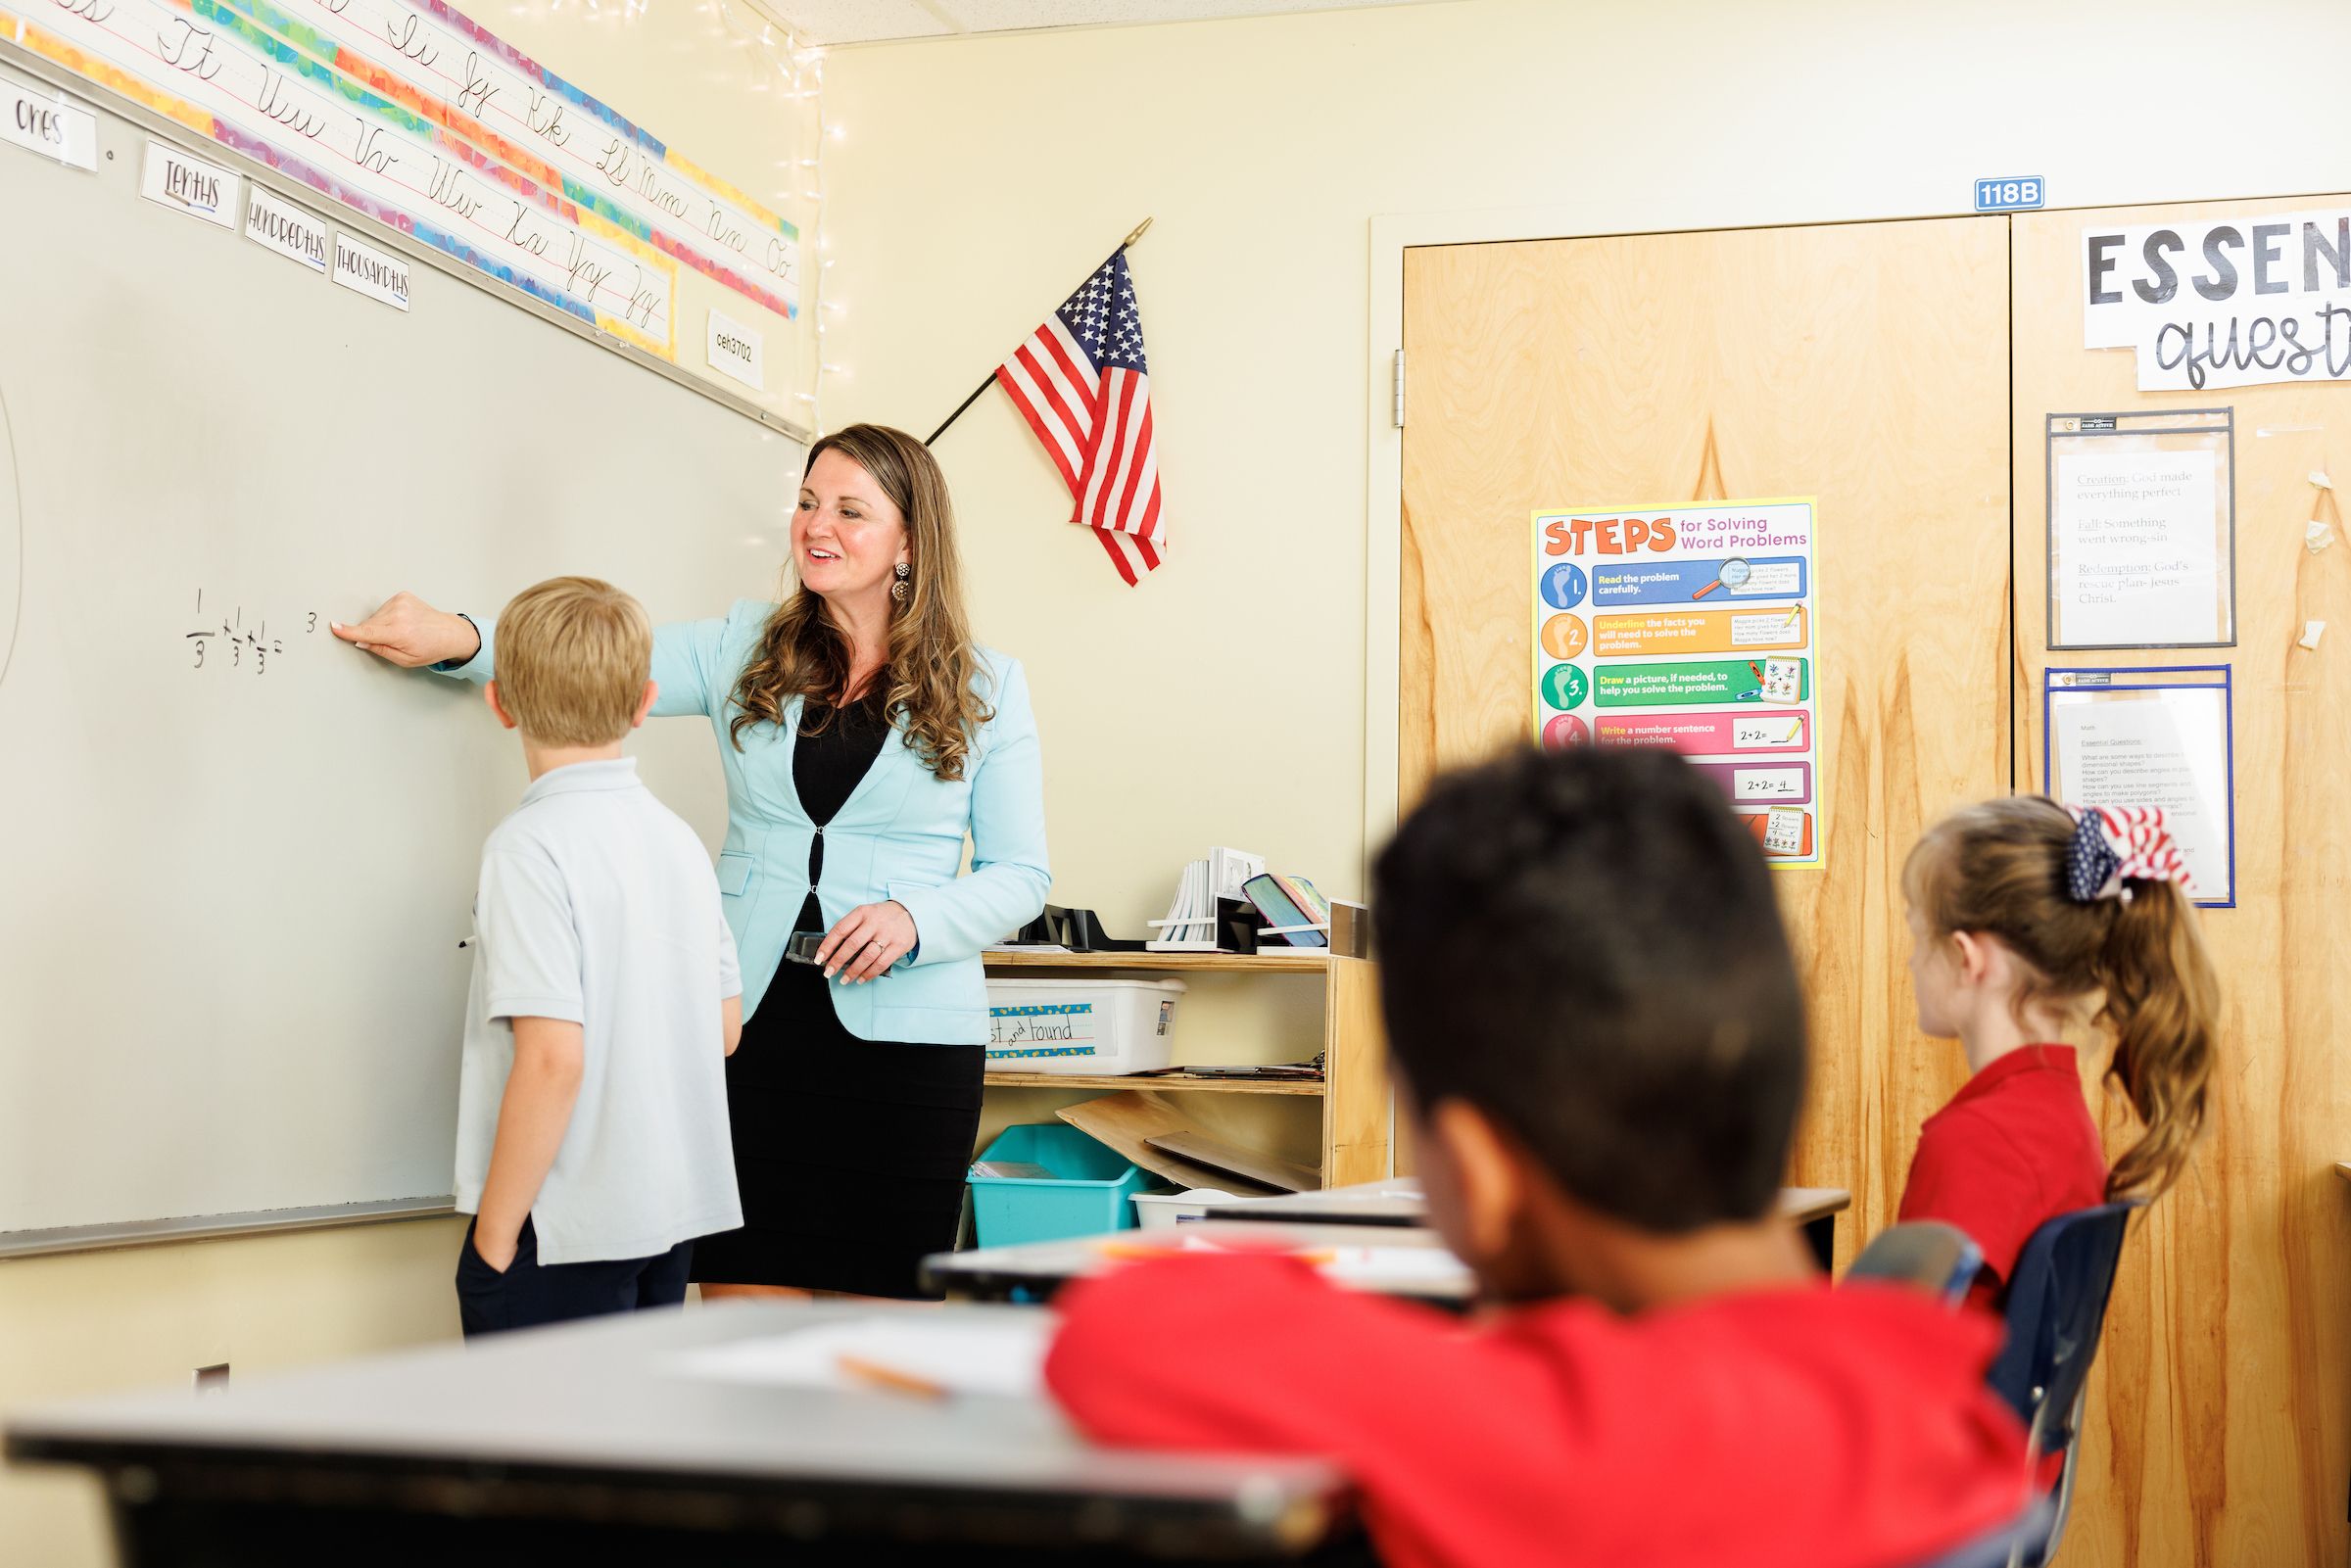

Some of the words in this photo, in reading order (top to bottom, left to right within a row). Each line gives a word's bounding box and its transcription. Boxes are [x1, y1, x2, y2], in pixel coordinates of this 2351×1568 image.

[456, 51, 500, 119] Jj
[526, 85, 571, 147] Kk
[596, 138, 633, 186] Ll
[638, 155, 689, 218] Mm
[705, 199, 748, 253] Nn
[766, 238, 792, 278] Oo
[157, 16, 222, 80] Tt
[259, 63, 326, 138] Uu
[356, 117, 400, 174] Vv
[427, 155, 483, 219] Ww
[504, 201, 551, 256] Xx
[567, 230, 612, 303] Yy
[624, 264, 661, 328] Zz
[1980, 180, 2039, 206] 118B
[2087, 215, 2350, 306] ESSEN
[716, 331, 752, 363] ceh3702
[2131, 472, 2155, 484] God
[2159, 470, 2193, 483] made
[2077, 489, 2139, 502] everything
[2141, 487, 2182, 500] perfect
[1680, 520, 1702, 533] for
[1707, 517, 1768, 534] Solving
[2103, 517, 2167, 531] Something
[1545, 517, 1676, 555] STEPS
[1681, 535, 1724, 549] Word
[1730, 532, 1807, 548] Problems
[2078, 534, 2106, 545] went
[2154, 560, 2189, 572] God's
[1599, 575, 1622, 584] Read
[1640, 573, 1680, 585] problem
[2078, 580, 2114, 589] rescue
[2149, 576, 2180, 590] Jesus
[1599, 585, 1642, 595] carefully.
[2078, 594, 2117, 605] Christ.
[1599, 619, 1645, 630] Underline
[1663, 618, 1686, 627] facts
[1688, 618, 1705, 629] you
[1568, 629, 1582, 646] 2.
[1599, 630, 1616, 640] will
[1617, 629, 1642, 639] need
[1655, 628, 1679, 638] solve
[1680, 628, 1697, 637] the
[1599, 640, 1642, 651] problem.
[1600, 676, 1624, 685] Draw
[1633, 675, 1669, 686] picture,
[1669, 674, 1678, 683] if
[1679, 673, 1716, 684] needed,
[1717, 672, 1728, 683] to
[1568, 680, 1583, 697] 3.
[1600, 686, 1621, 696] help
[1622, 687, 1641, 696] you
[1642, 684, 1667, 693] solve
[1667, 684, 1684, 692] the
[1685, 683, 1728, 694] problem.
[1601, 727, 1626, 736] Write
[1635, 725, 1672, 735] number
[1673, 724, 1716, 734] sentence
[1616, 736, 1632, 744] the
[1633, 734, 1677, 745] problem.
[1779, 781, 1787, 789] 4
[1008, 1021, 1027, 1047] and
